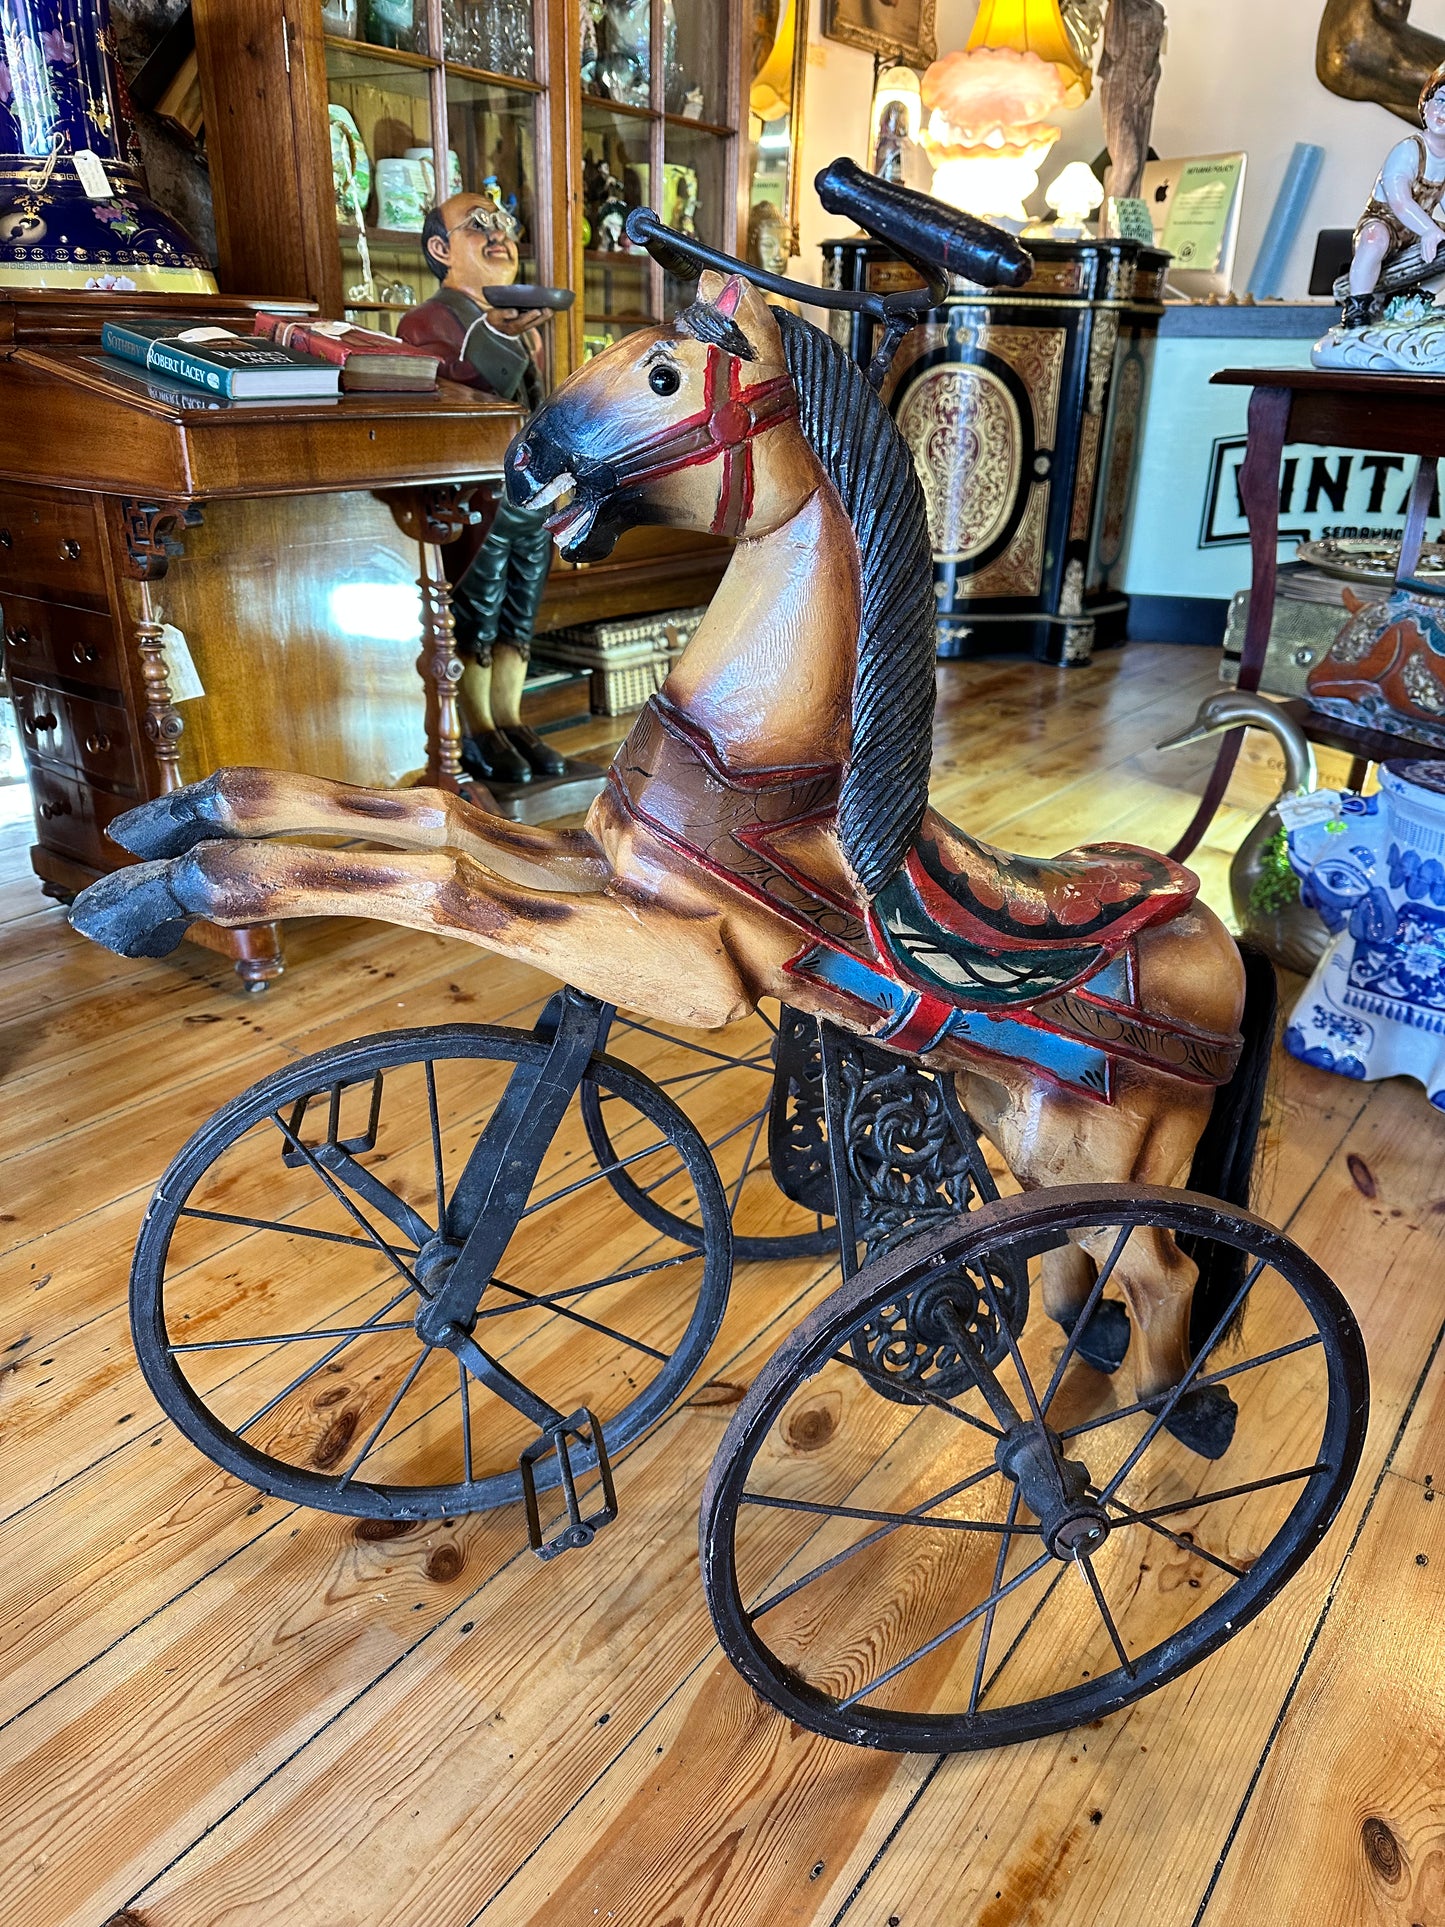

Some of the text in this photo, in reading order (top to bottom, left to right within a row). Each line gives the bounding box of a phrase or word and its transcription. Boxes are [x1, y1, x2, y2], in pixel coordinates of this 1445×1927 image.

[106, 330, 149, 357] SOTHEBY'S
[148, 348, 179, 373] ROBERT
[180, 359, 206, 383] LACEY
